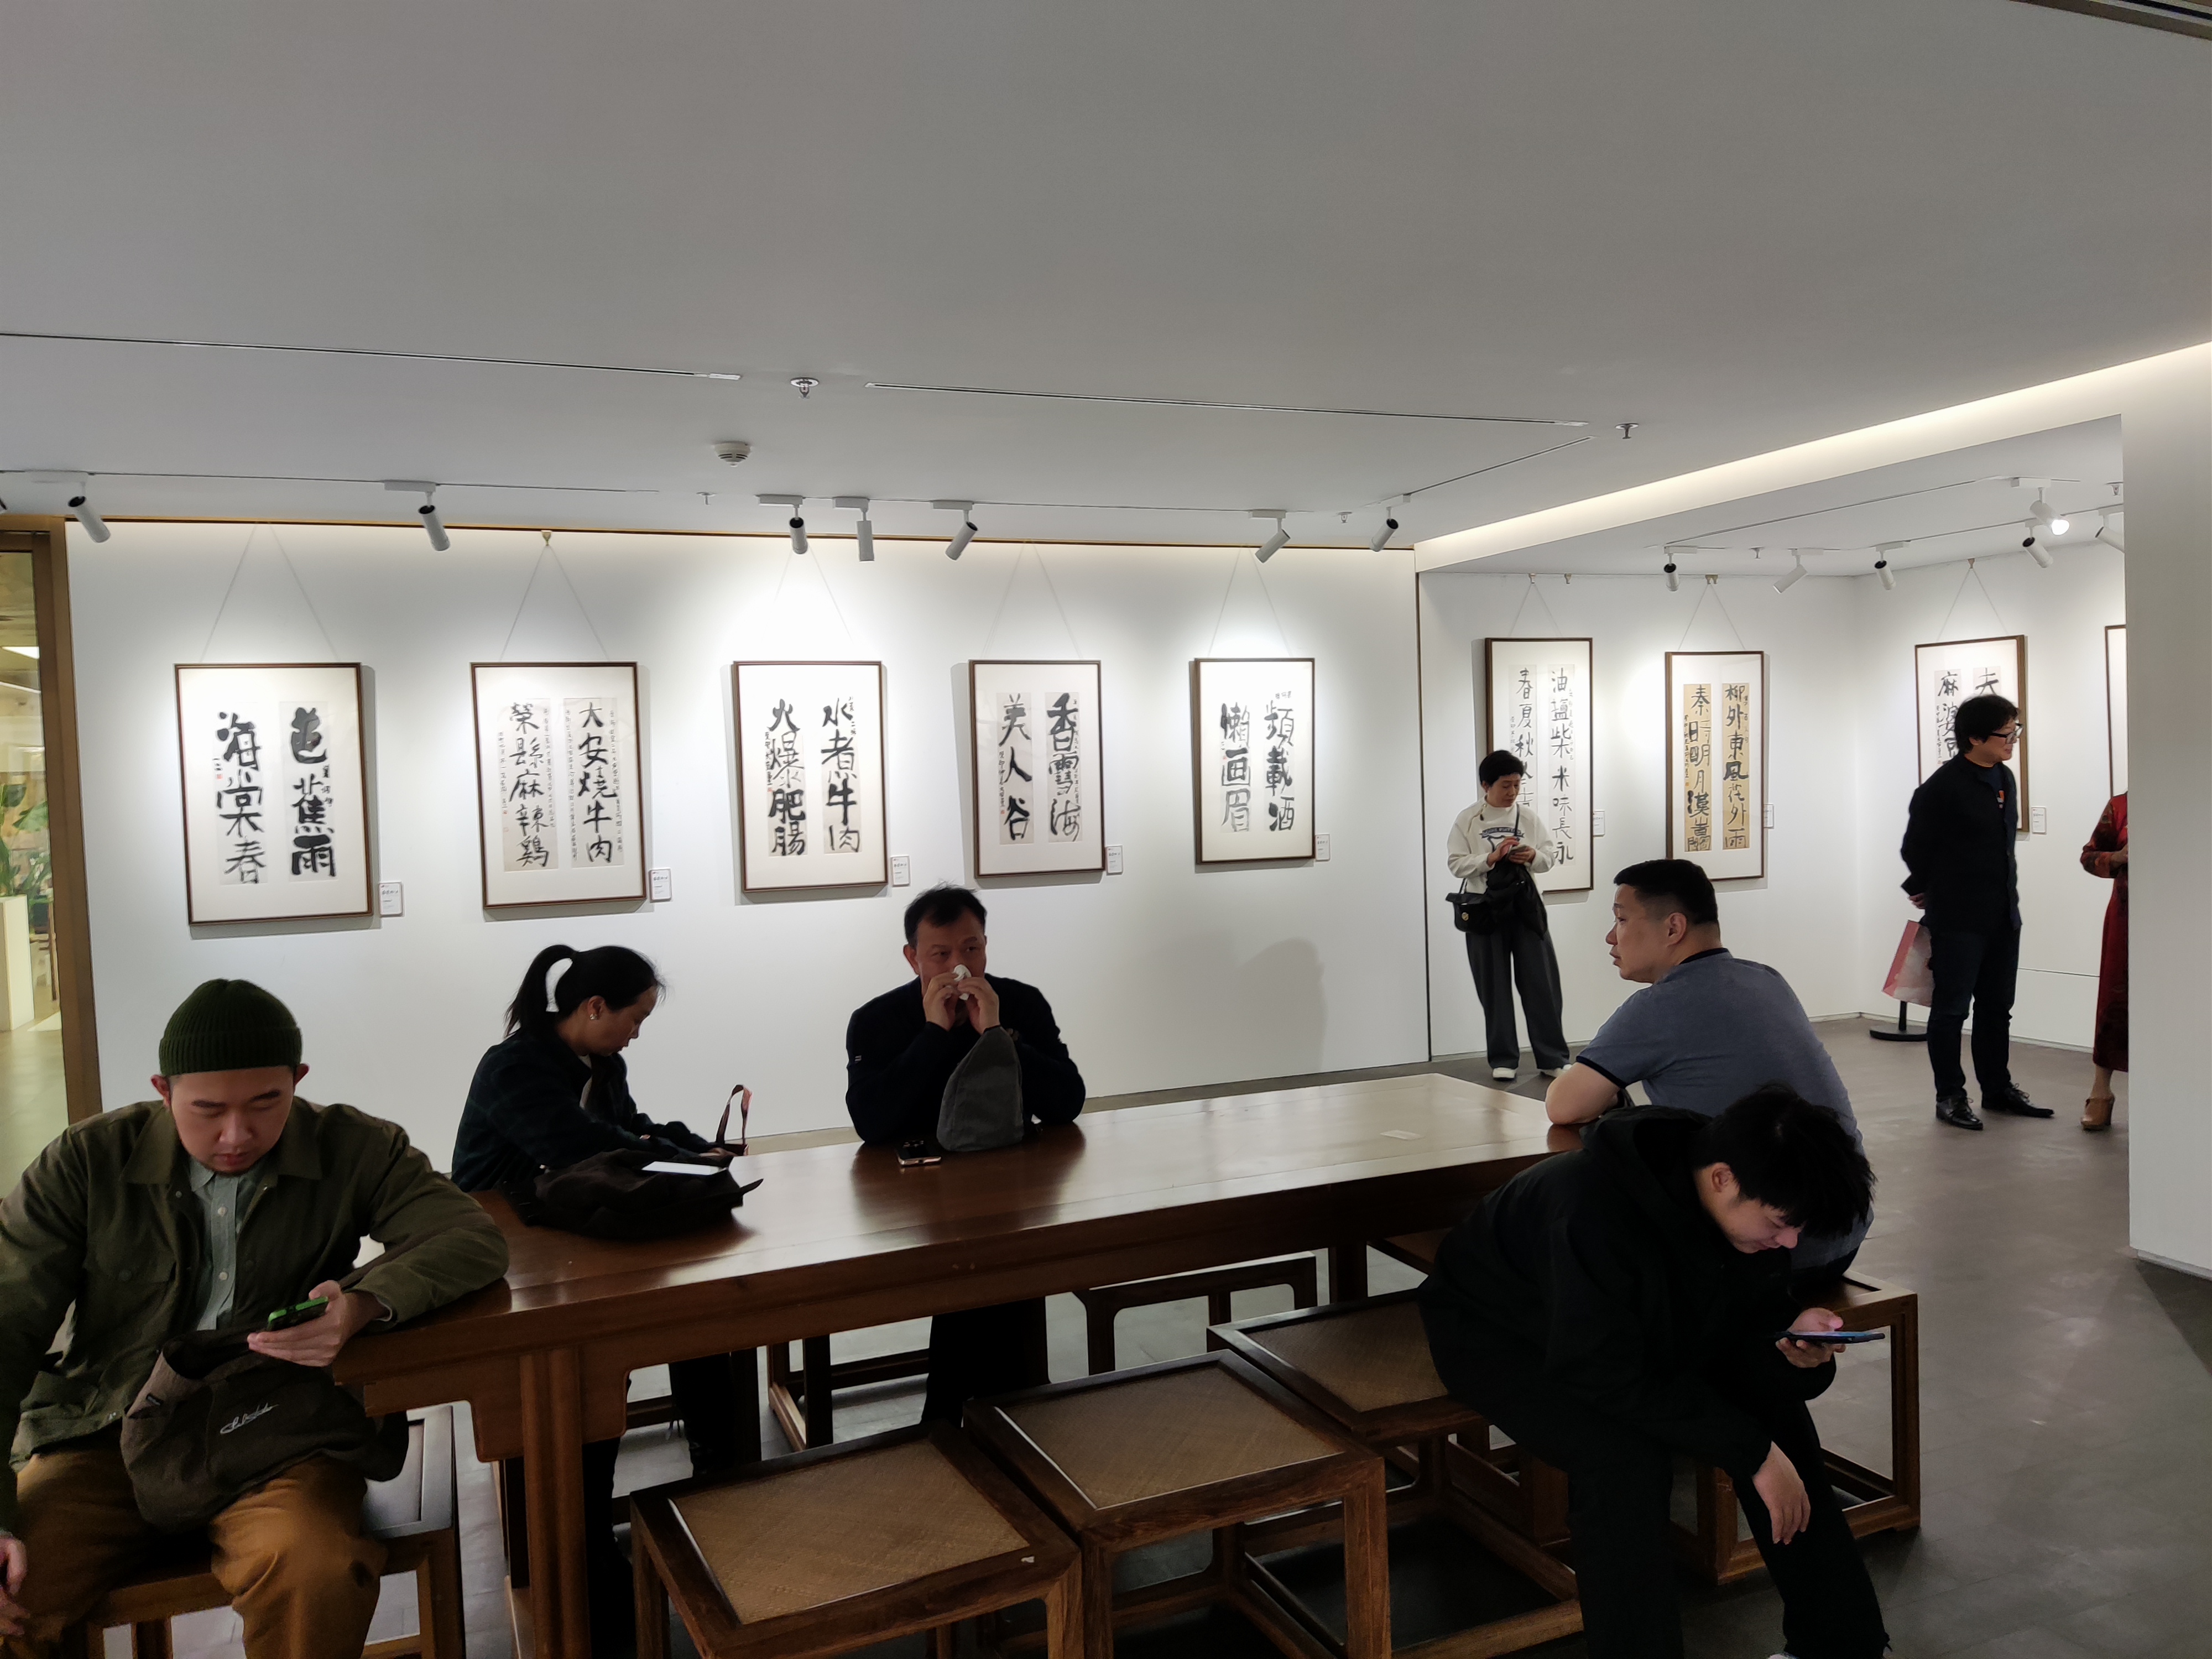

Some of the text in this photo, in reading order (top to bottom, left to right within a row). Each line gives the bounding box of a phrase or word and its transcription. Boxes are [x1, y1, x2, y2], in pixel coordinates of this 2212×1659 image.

[821, 698, 860, 852] 水煮牛肉
[999, 693, 1032, 841] 美人谷
[1046, 693, 1082, 842] 香雪海
[1937, 671, 1959, 765] 麻婆豆
[217, 711, 267, 884] 海棠春
